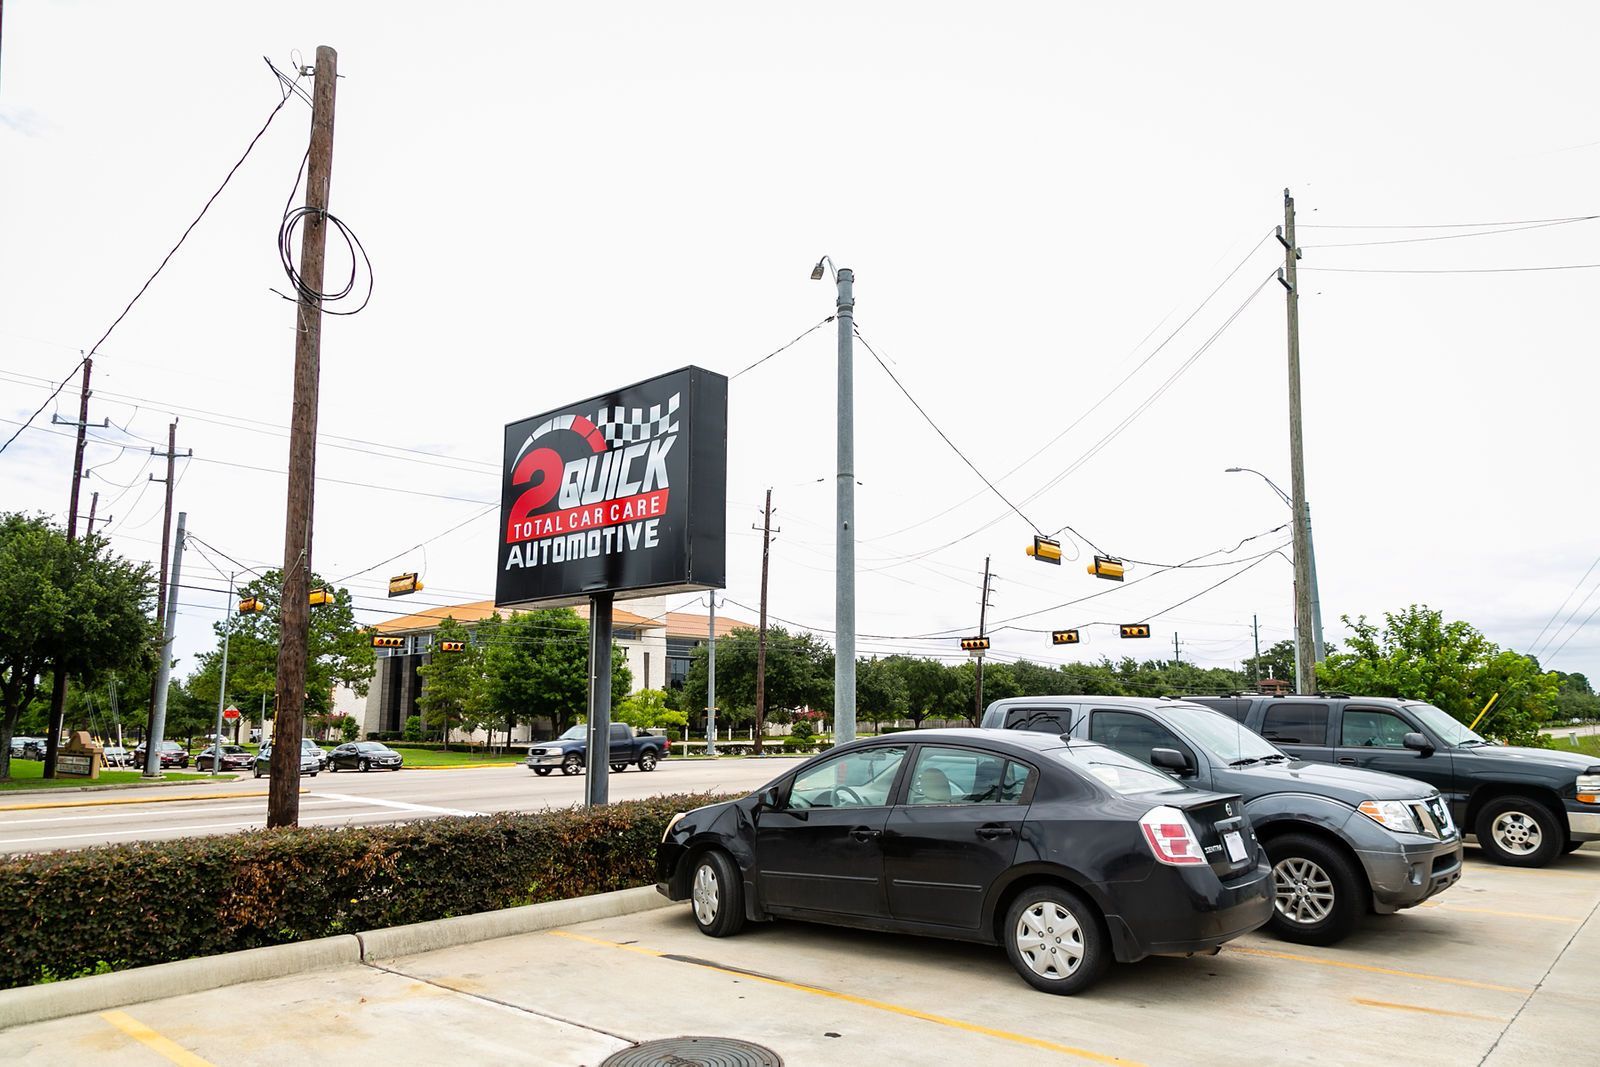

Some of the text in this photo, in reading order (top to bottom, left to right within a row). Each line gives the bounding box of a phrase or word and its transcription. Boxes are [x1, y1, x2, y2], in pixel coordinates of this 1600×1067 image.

[514, 496, 660, 540] TOTAL CAR CARE
[505, 518, 660, 570] AUTOMOTIVE
